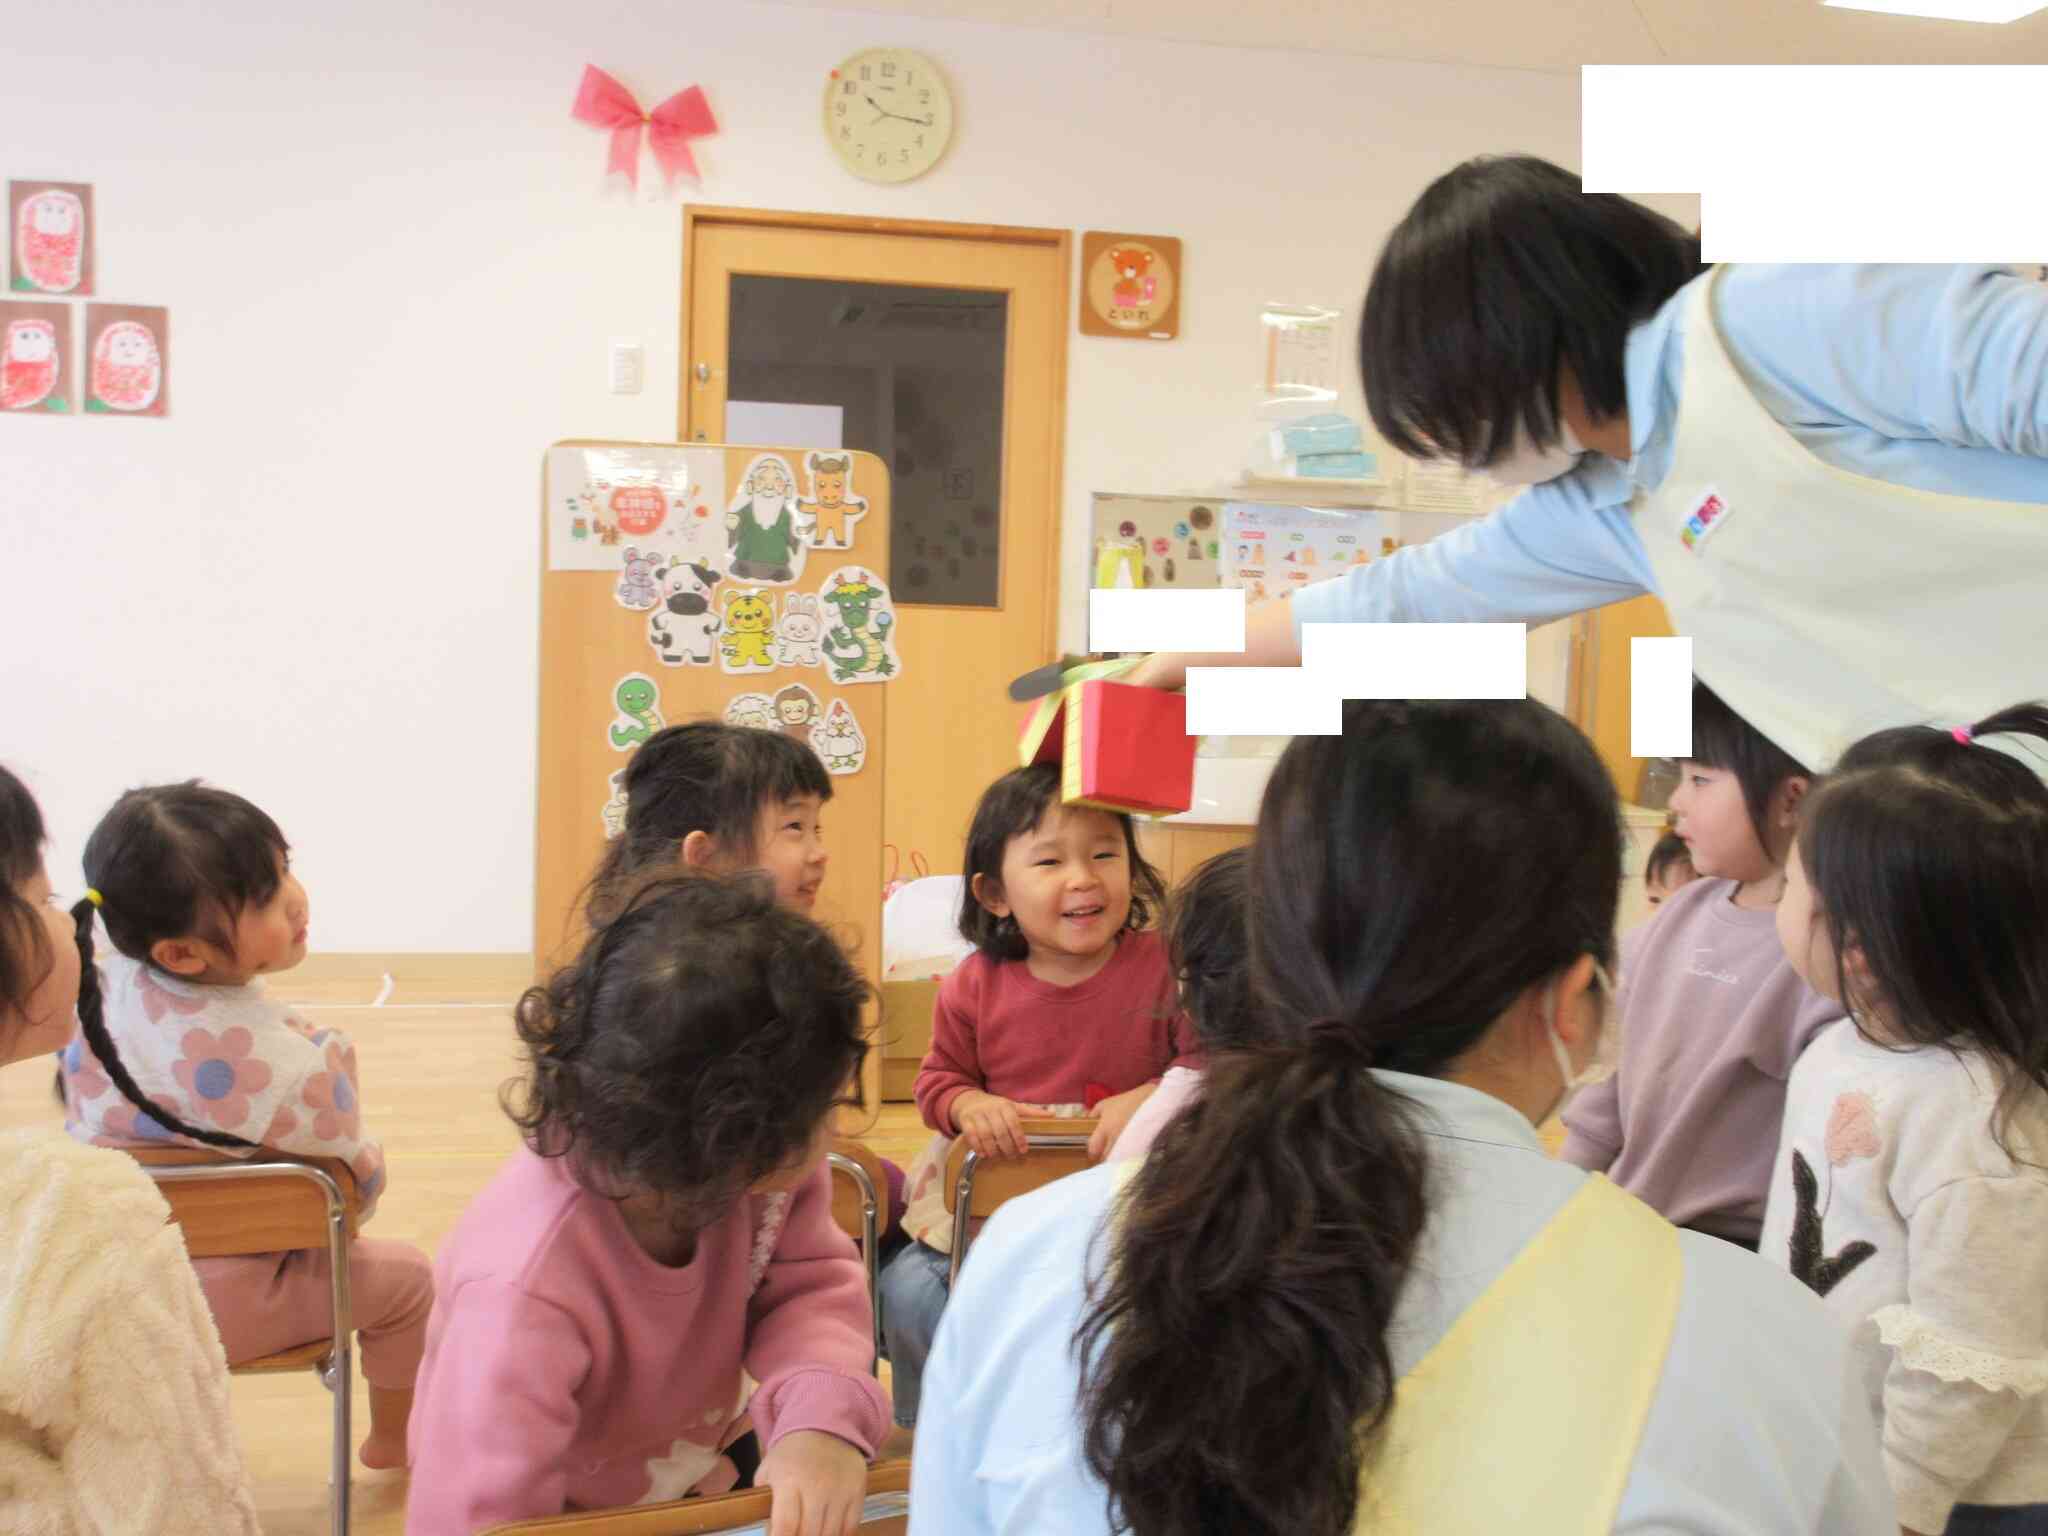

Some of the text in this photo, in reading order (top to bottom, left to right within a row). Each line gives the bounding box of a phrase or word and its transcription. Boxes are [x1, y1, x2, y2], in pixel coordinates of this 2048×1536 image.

[860, 65, 871, 81] 11
[880, 61, 896, 78] 12
[843, 80, 857, 95] 10
[836, 101, 847, 117] 9
[913, 133, 924, 148] 4
